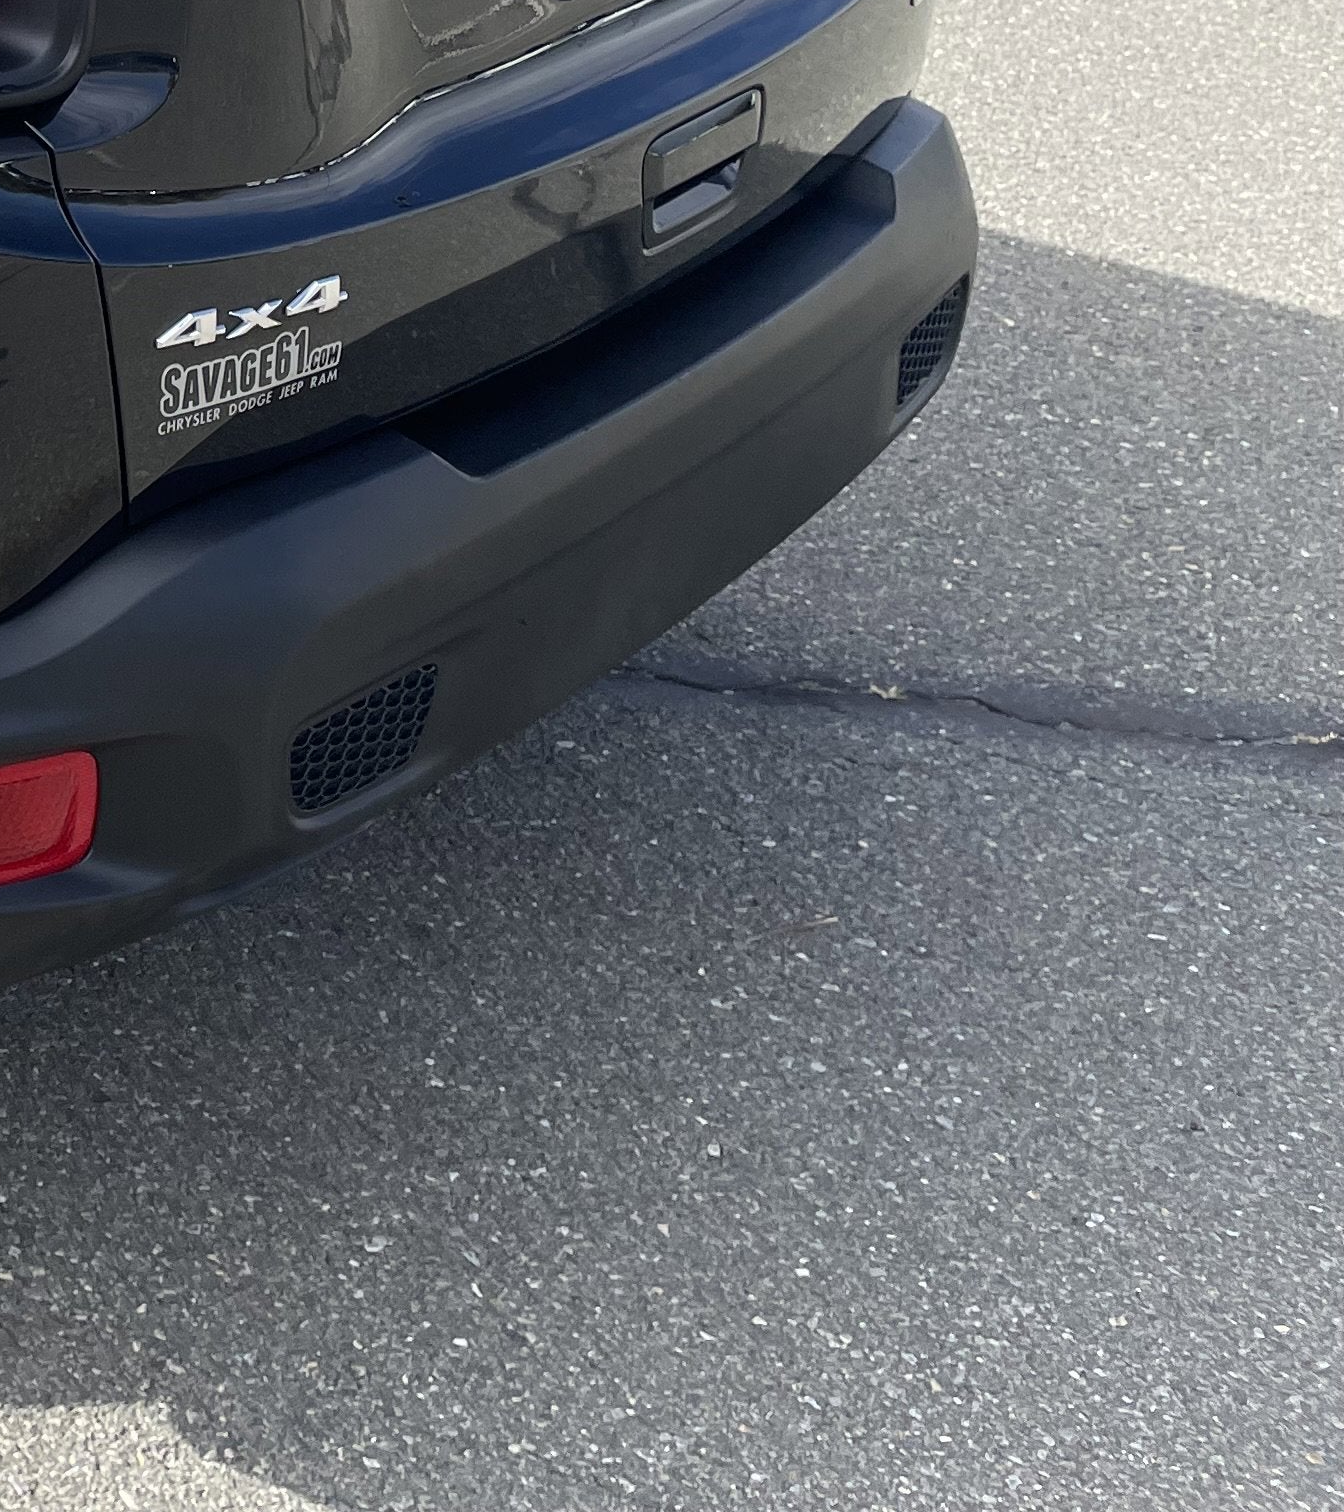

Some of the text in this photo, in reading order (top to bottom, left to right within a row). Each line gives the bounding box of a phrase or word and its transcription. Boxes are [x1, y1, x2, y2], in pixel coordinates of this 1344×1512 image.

[156, 274, 349, 348] 4x4
[157, 368, 338, 436] CHRYSLER DODGE JEEP RAM
